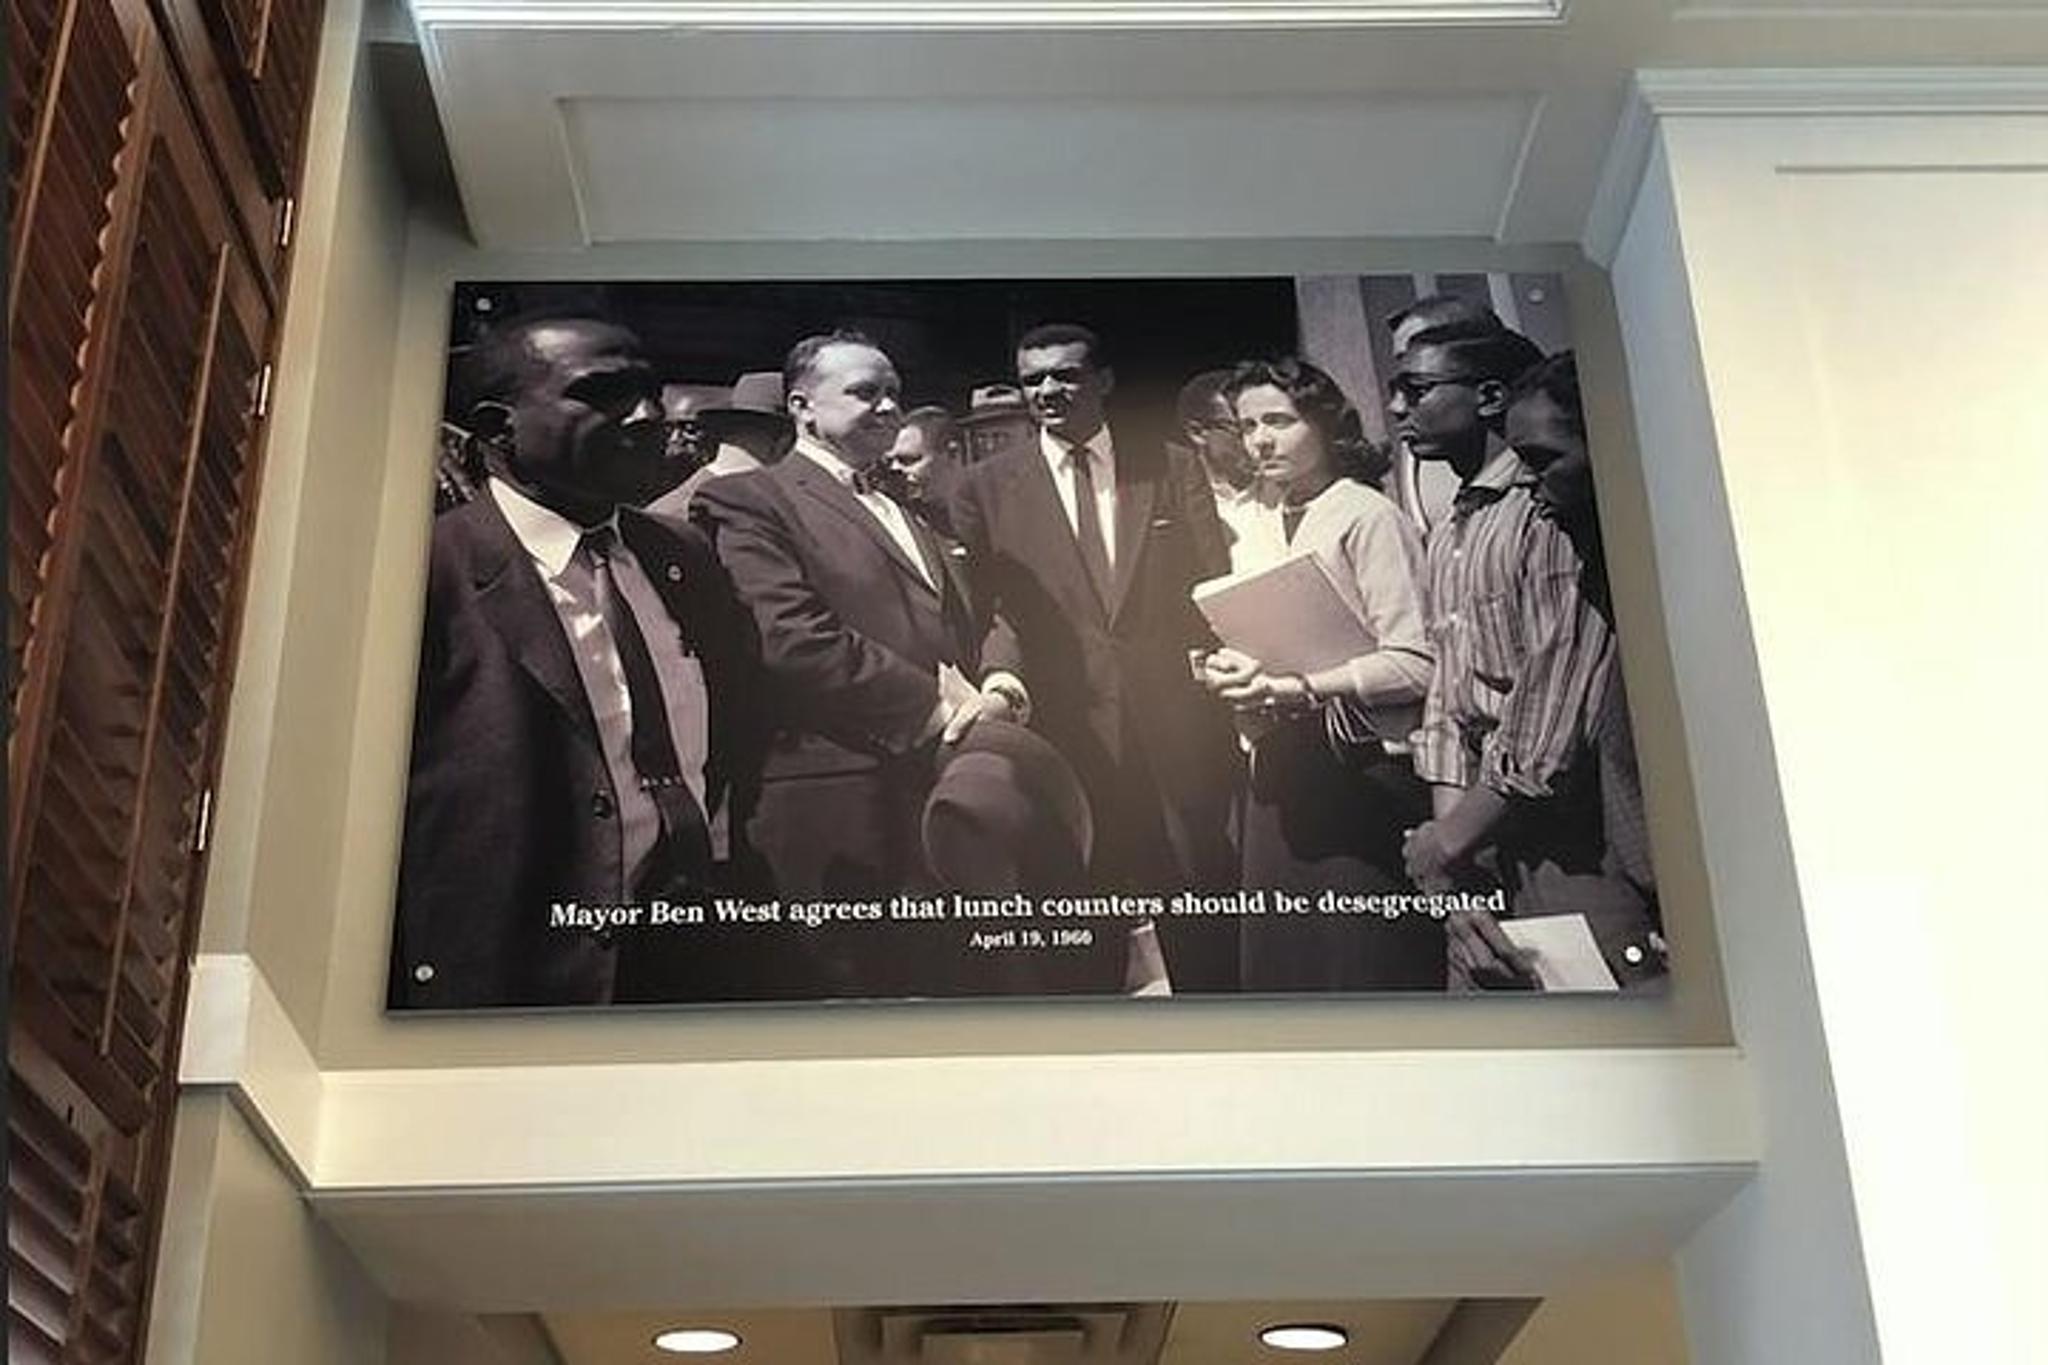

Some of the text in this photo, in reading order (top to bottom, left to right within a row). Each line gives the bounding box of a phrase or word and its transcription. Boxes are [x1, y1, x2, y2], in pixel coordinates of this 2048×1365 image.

[551, 889, 1506, 931] Mayor Ben West agrees that lunch counters should be desegregated
[969, 930, 1016, 950] April
[1021, 930, 1046, 948] 19,
